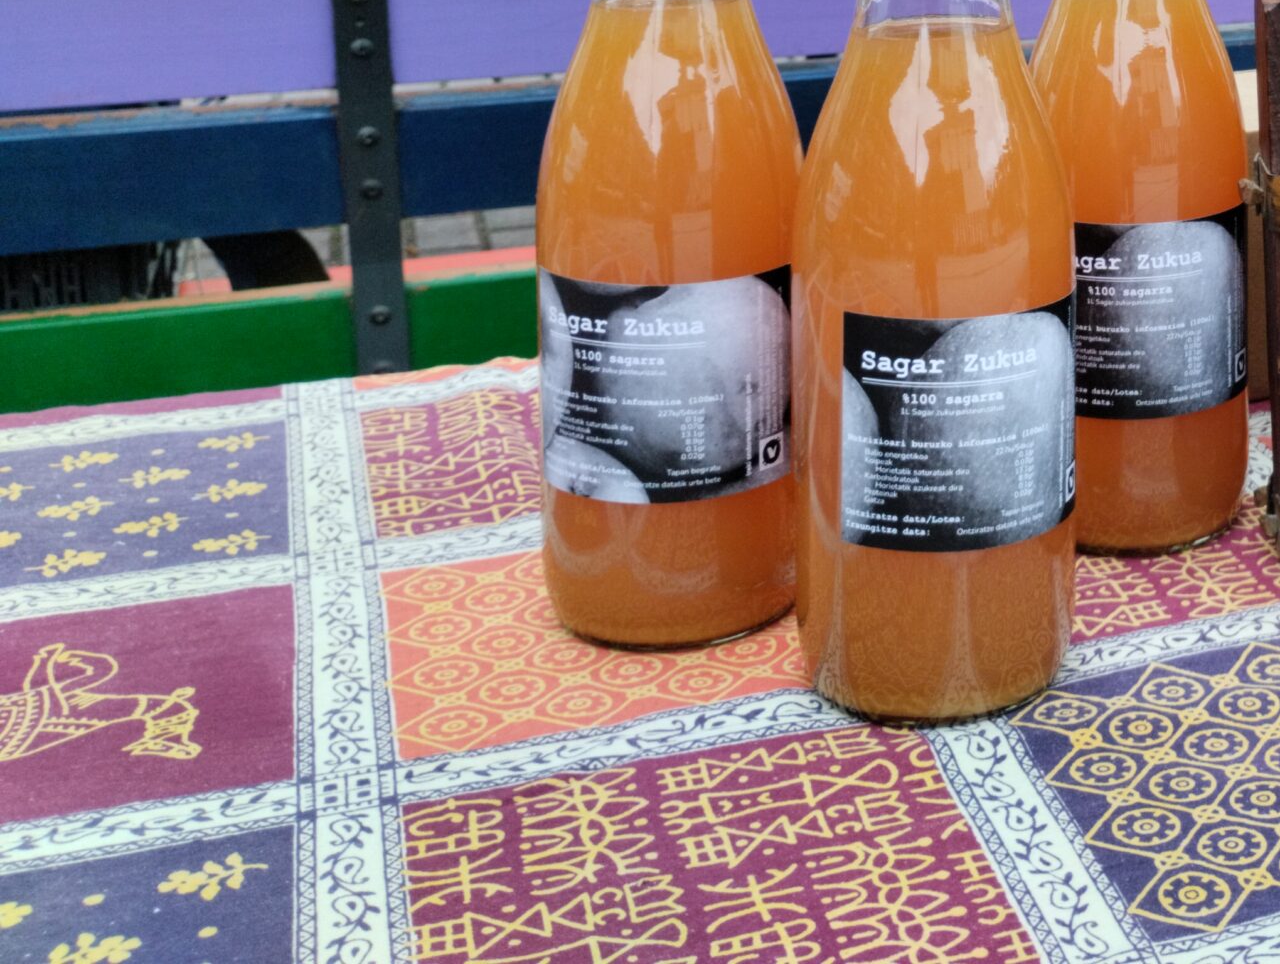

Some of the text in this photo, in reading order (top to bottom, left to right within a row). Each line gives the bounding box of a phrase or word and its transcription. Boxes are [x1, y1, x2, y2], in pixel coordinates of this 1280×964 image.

[1136, 250, 1203, 270] Zukua
[1087, 285, 1173, 298] %100 sagarra
[548, 305, 706, 336] Sagar Zukua
[574, 348, 665, 367] %100 sagarra
[861, 347, 1038, 379] Sagar Zukua
[902, 391, 1005, 407] %100 sagarra
[911, 408, 935, 418] Sagar
[911, 439, 953, 449] buruzko
